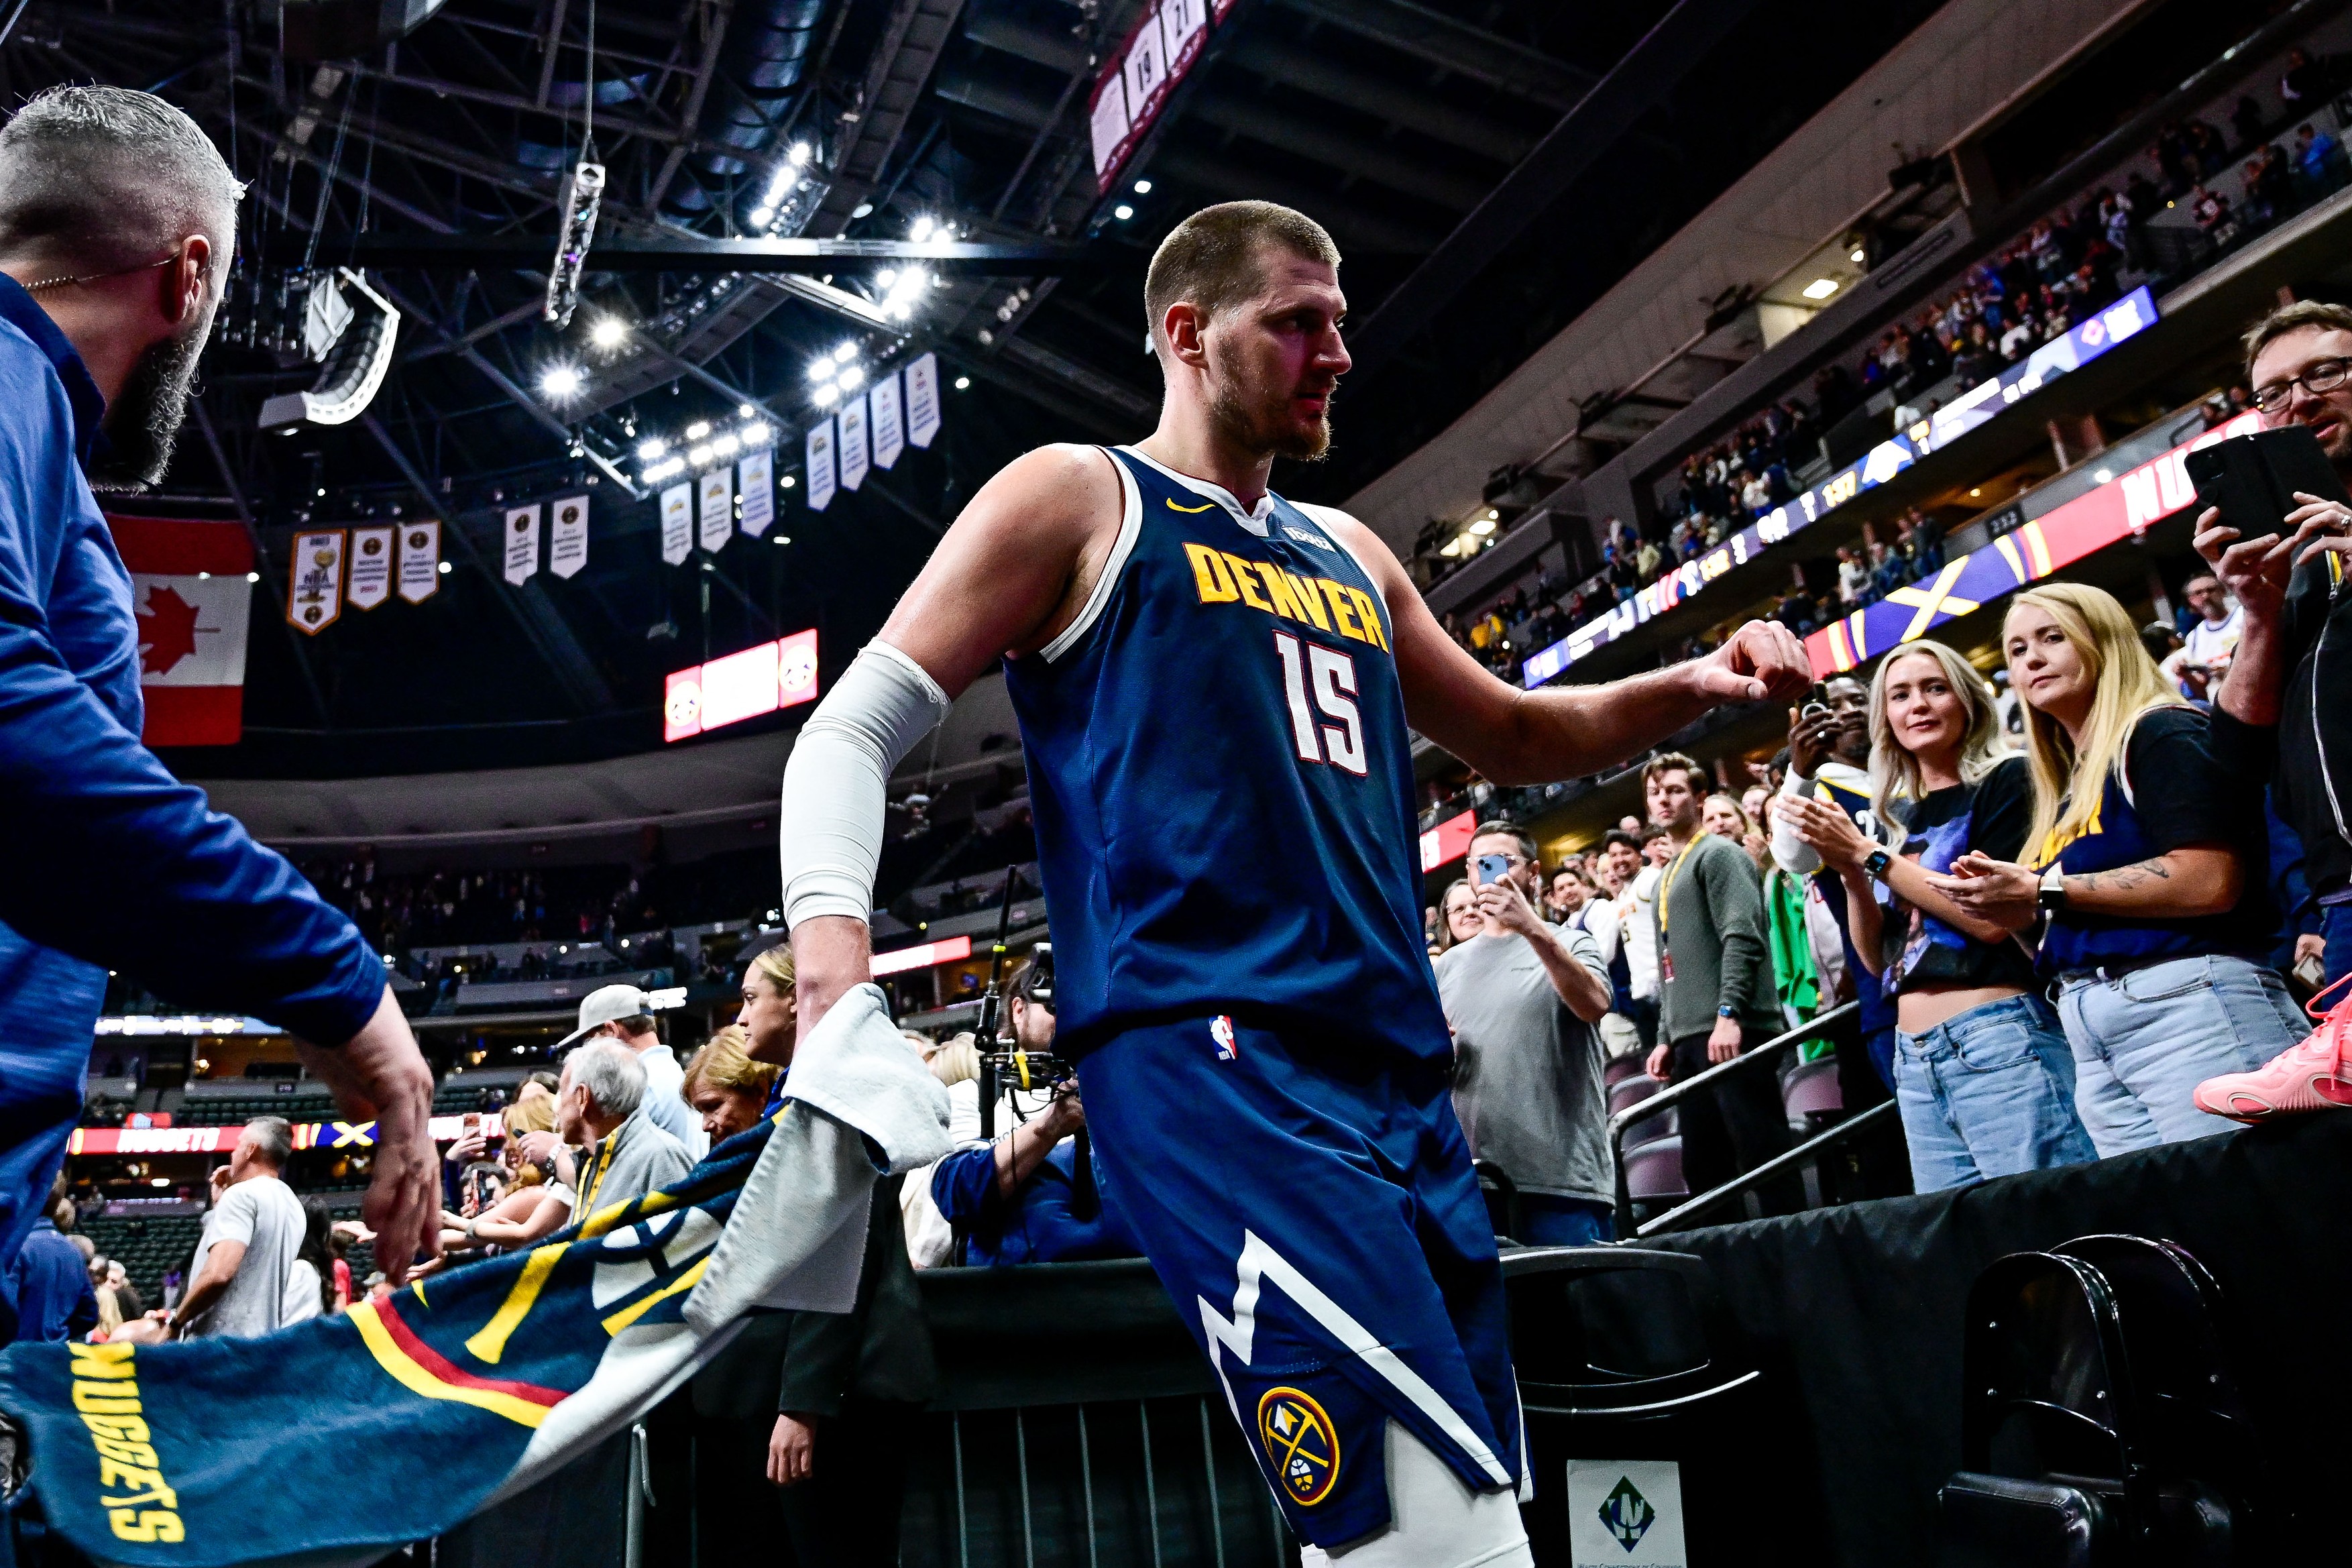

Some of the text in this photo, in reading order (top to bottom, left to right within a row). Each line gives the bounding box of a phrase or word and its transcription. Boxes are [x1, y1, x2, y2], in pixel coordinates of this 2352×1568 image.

[1182, 542, 1390, 654] DENVER
[1272, 629, 1369, 777] 15
[68, 1341, 186, 1543] NUGGETS
